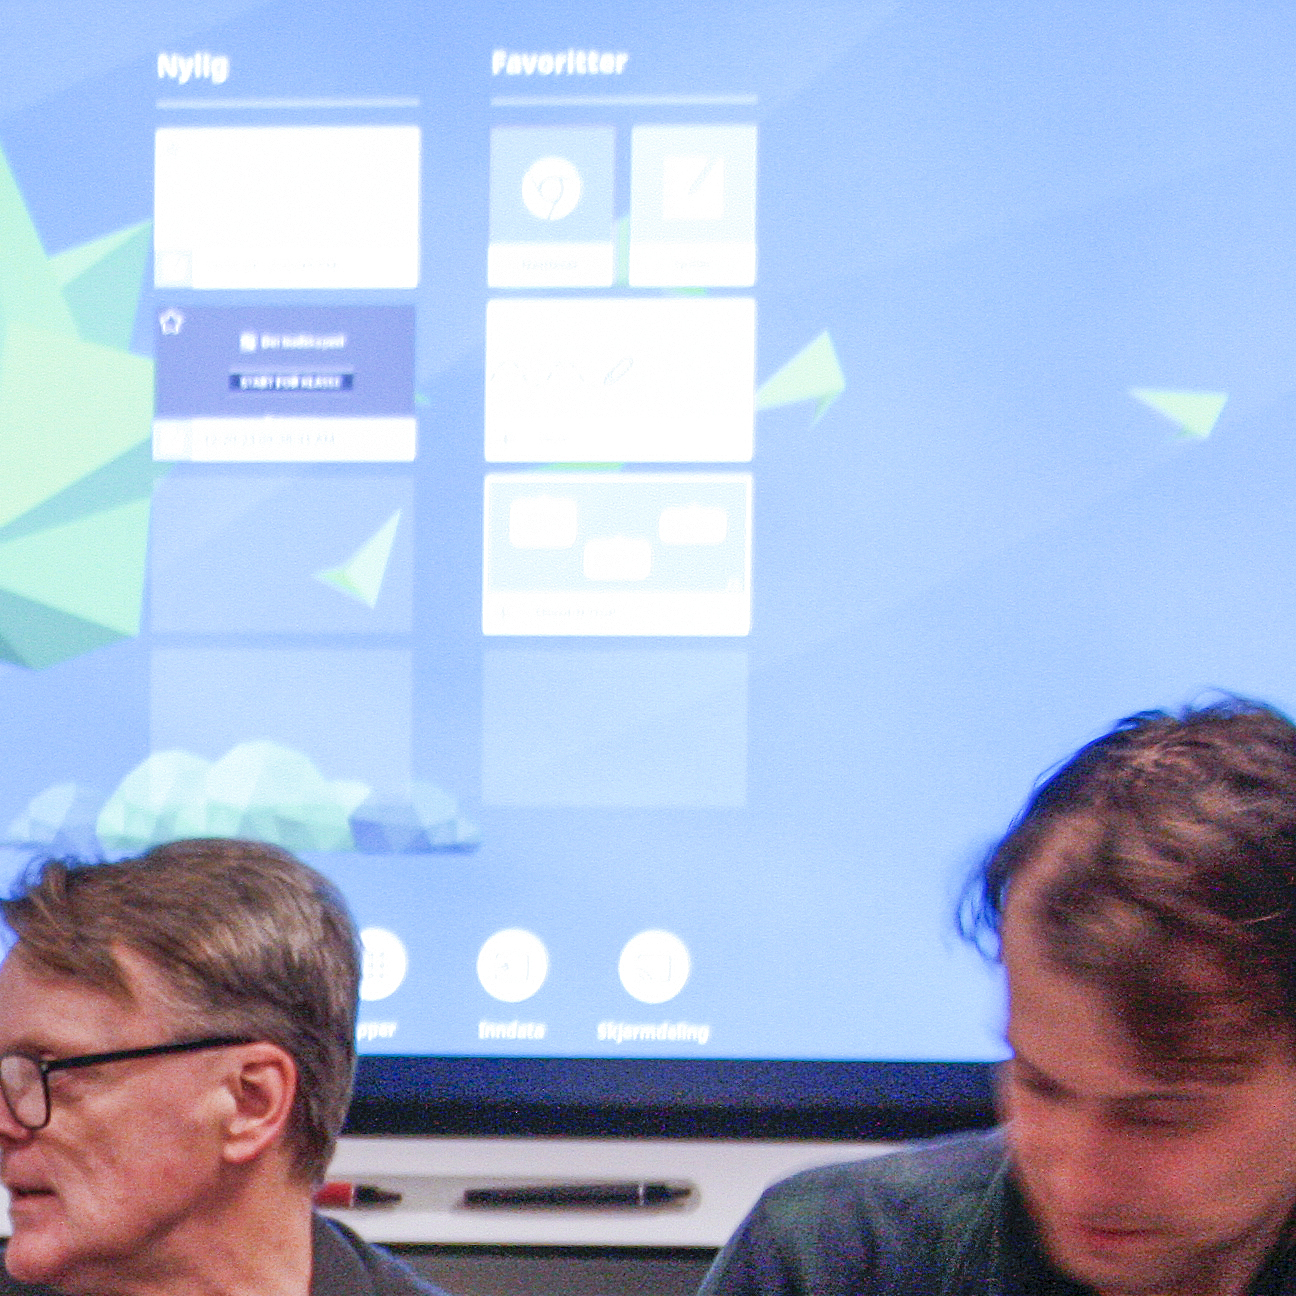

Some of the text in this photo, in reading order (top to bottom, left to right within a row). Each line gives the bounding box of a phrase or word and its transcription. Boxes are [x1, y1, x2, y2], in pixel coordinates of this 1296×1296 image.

[157, 51, 230, 84] Nylig
[491, 47, 629, 78] Favoritter
[357, 1022, 398, 1040] pper
[478, 1021, 547, 1040] Inndata
